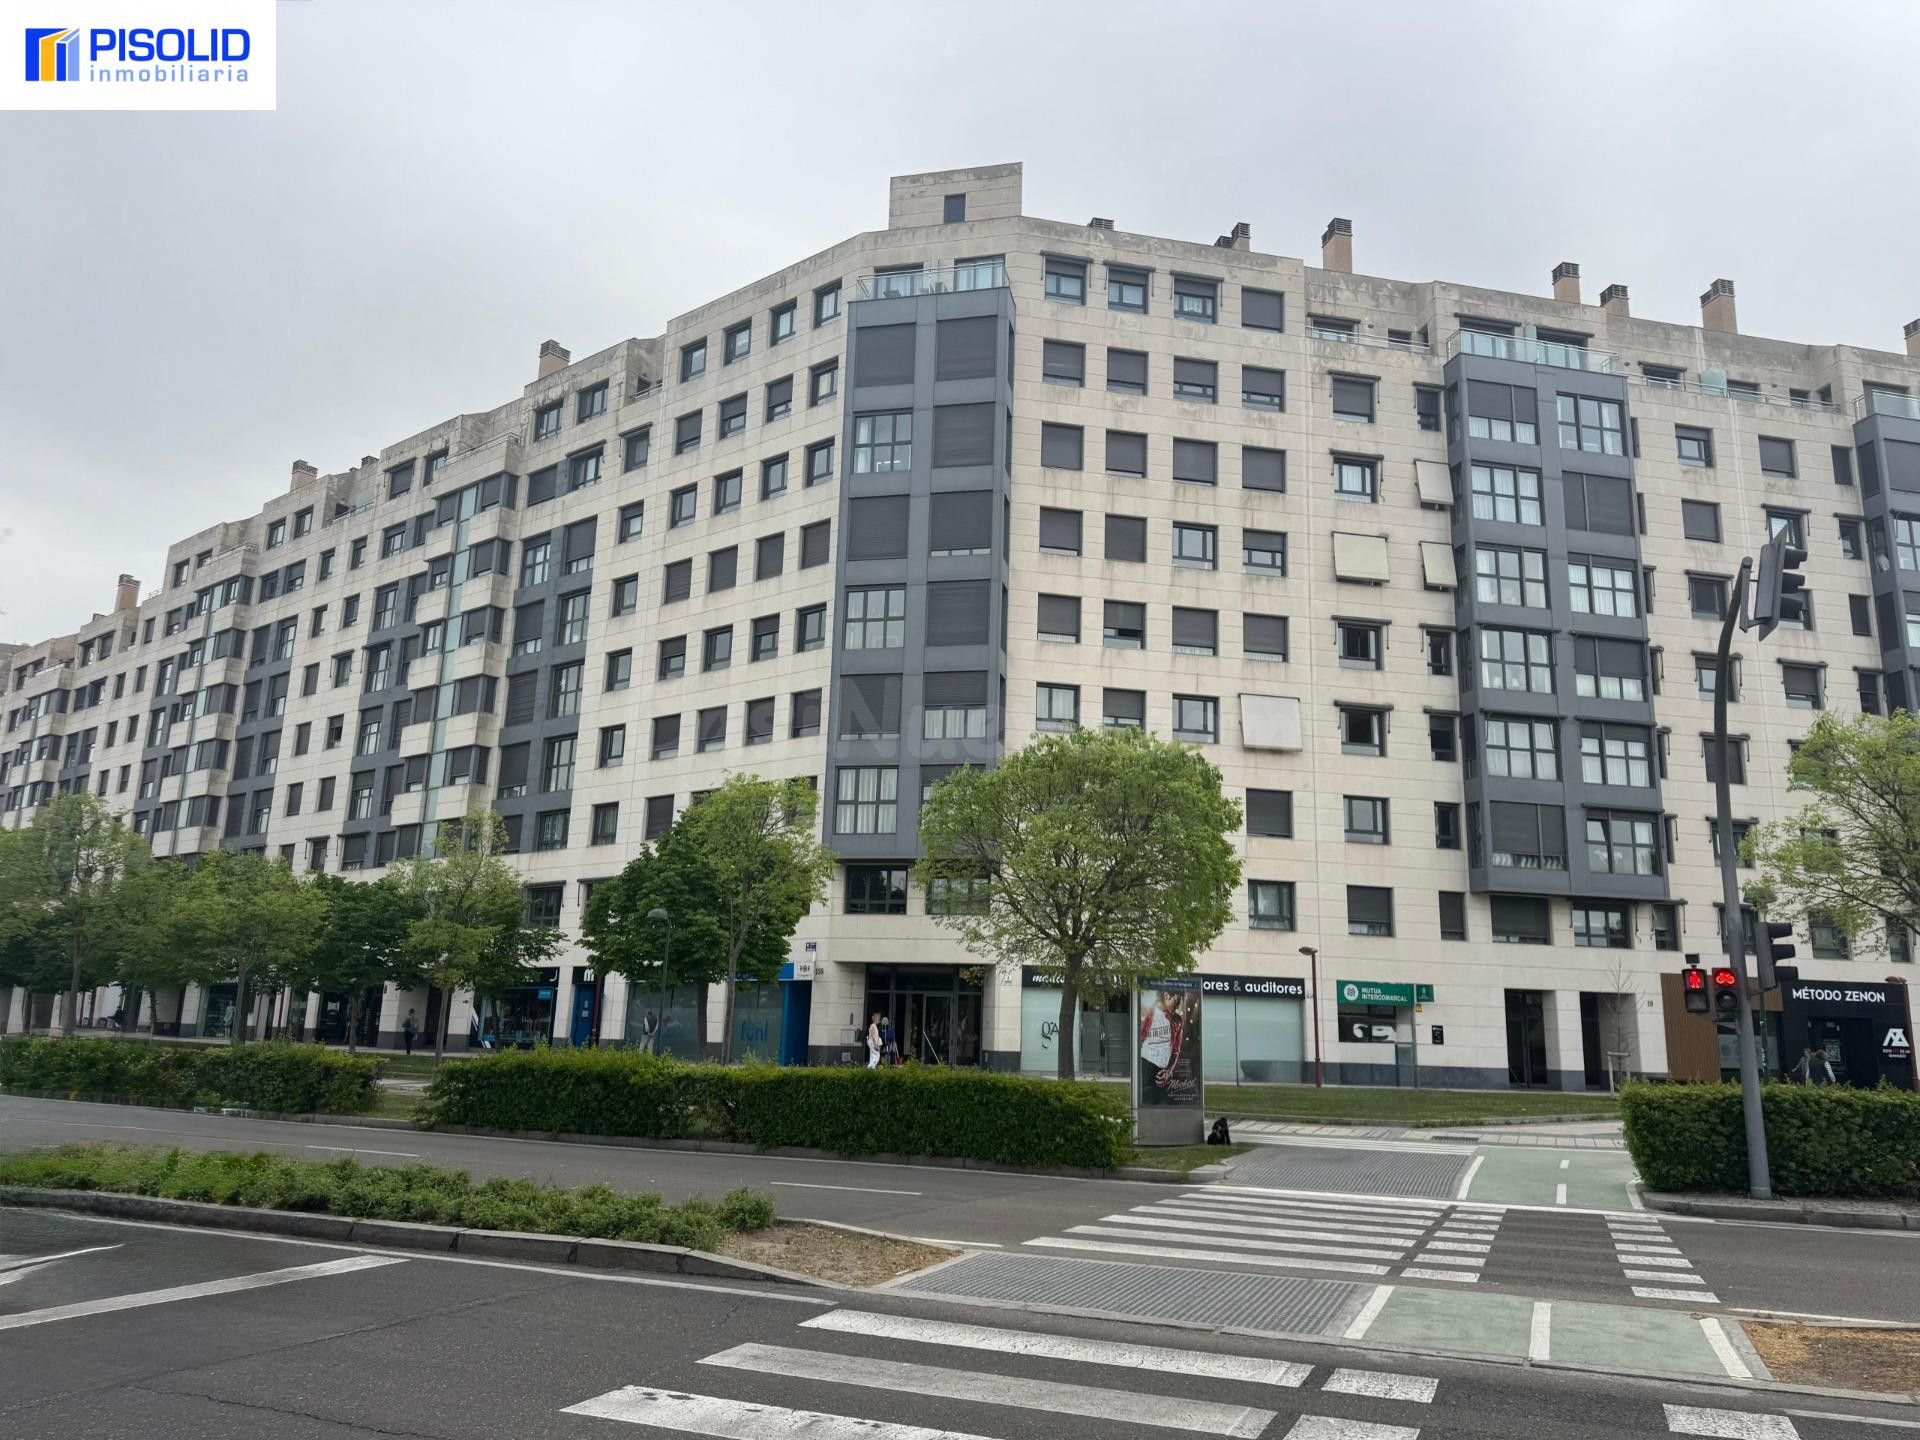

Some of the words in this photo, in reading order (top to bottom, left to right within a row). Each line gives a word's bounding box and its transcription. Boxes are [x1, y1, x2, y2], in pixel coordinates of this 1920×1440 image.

[1203, 981, 1230, 991] ores
[1233, 980, 1241, 992] &
[1244, 981, 1303, 995] auditores
[1792, 986, 1842, 1001] MÉTODO
[1844, 990, 1886, 1003] ZENON
[1361, 993, 1408, 1002] INTERCOMARCAL
